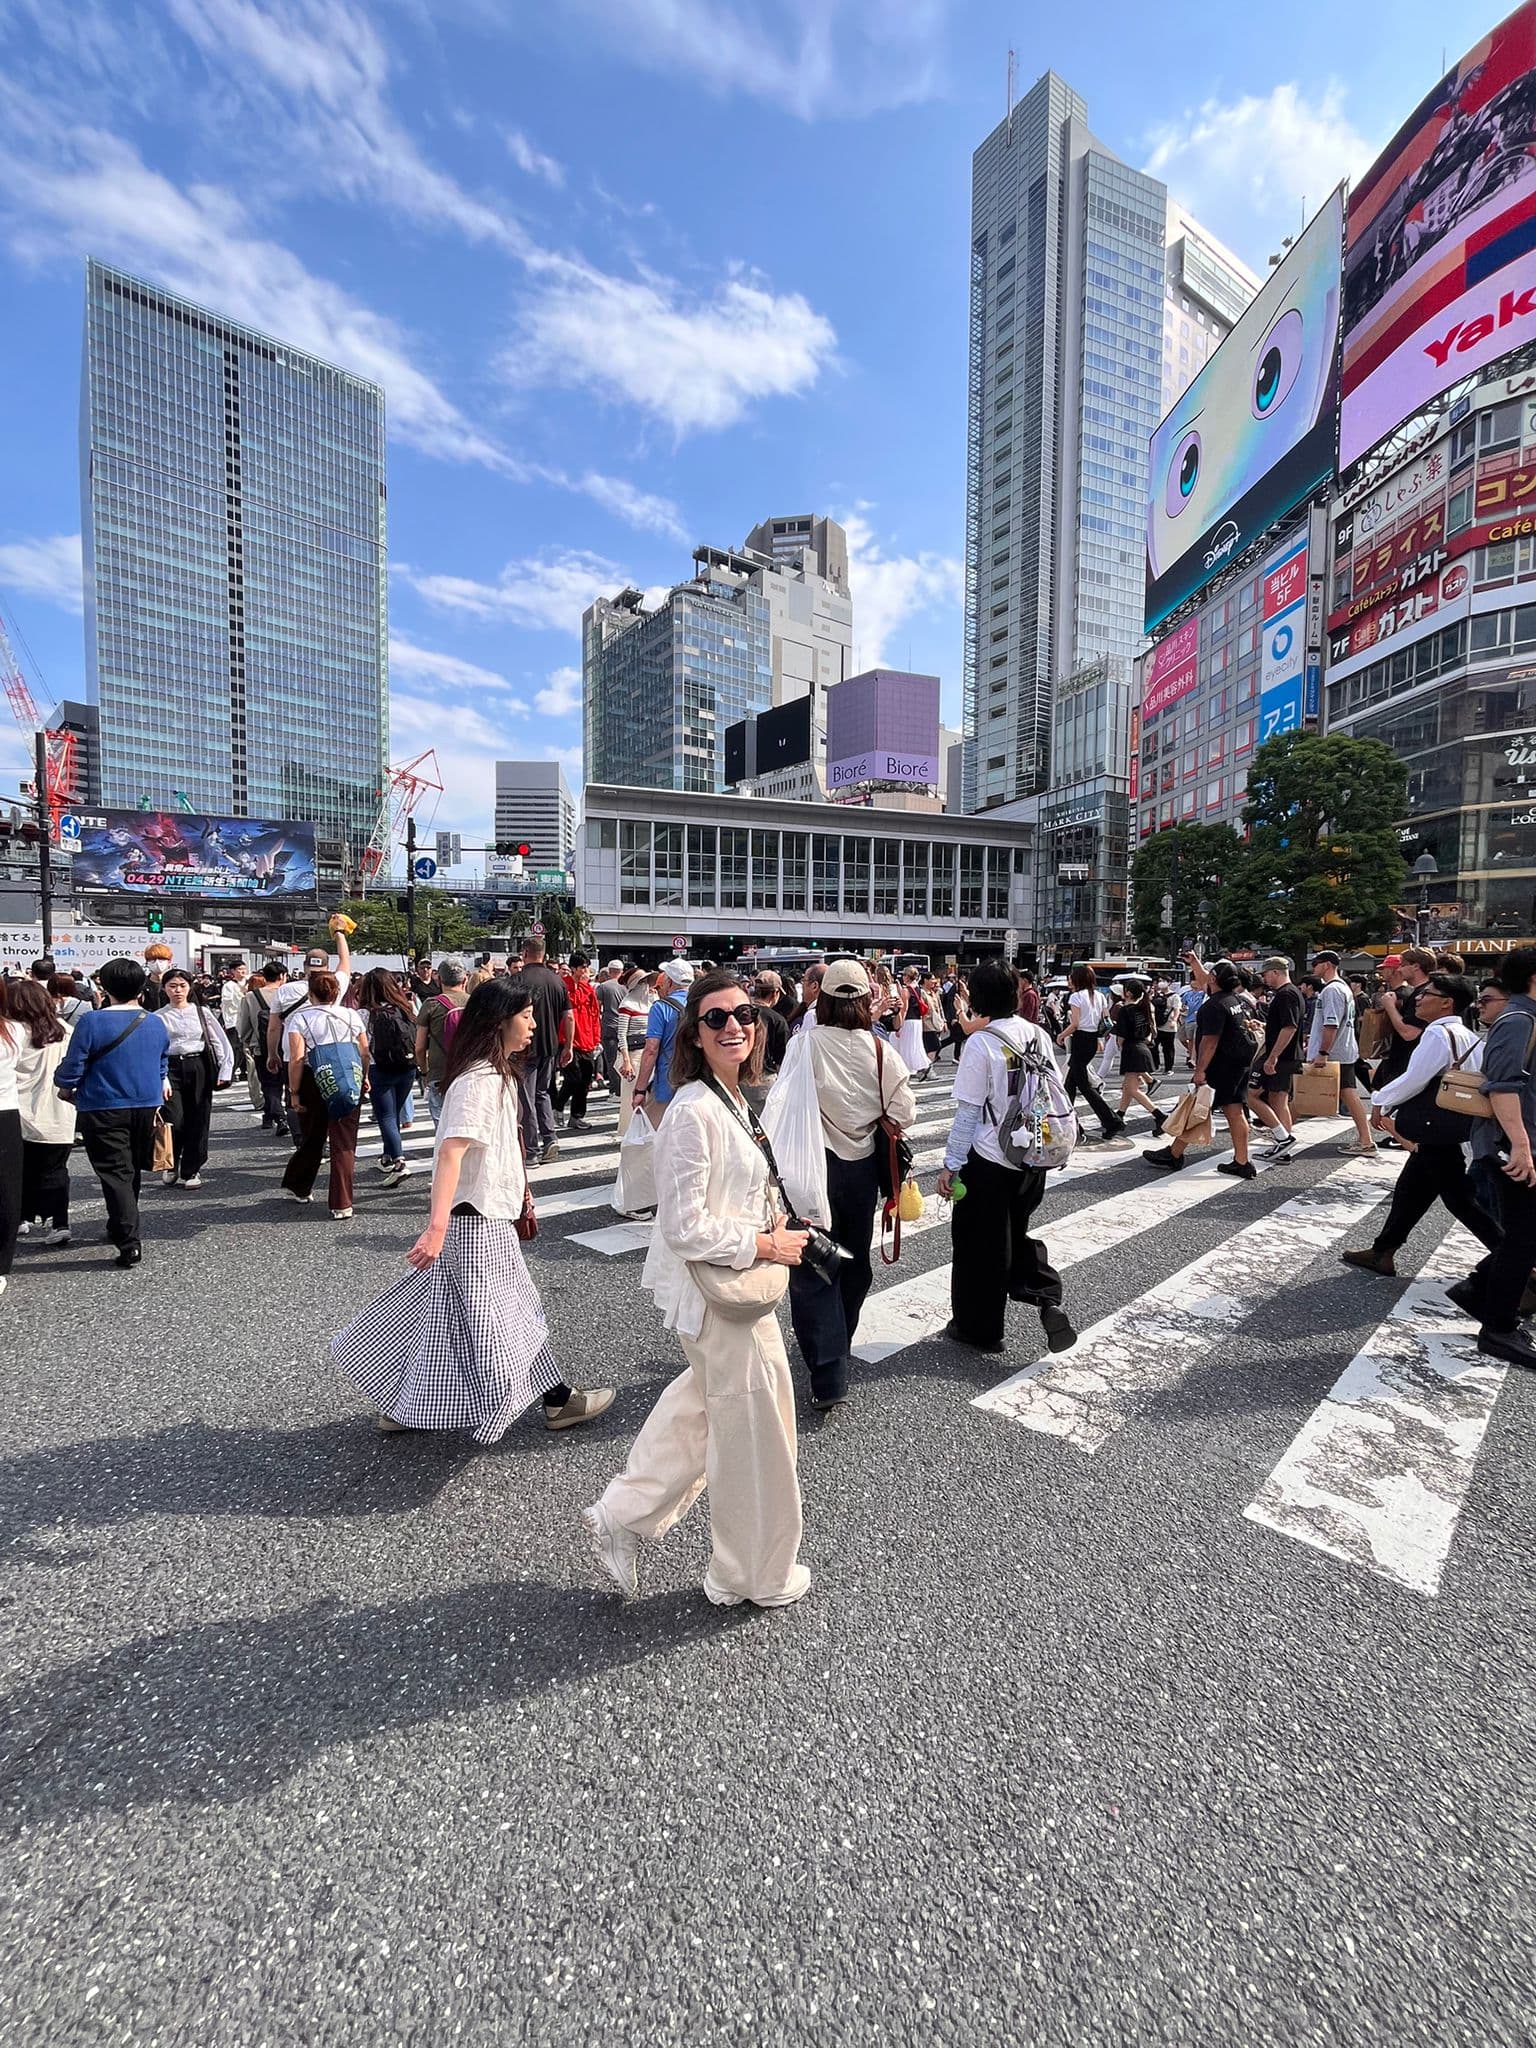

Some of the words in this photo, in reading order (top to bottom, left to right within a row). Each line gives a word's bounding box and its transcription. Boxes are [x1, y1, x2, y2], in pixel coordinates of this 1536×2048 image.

[1337, 524, 1353, 546] 9F
[1270, 565, 1299, 594] 当ビル
[1401, 549, 1448, 590] ガスト
[1276, 586, 1292, 606] 5F
[1378, 591, 1434, 642] ガスト
[1332, 635, 1350, 658] 7F
[833, 758, 867, 783] Bioré
[886, 757, 929, 777] Bioré
[1043, 815, 1072, 830] MARK
[1075, 806, 1105, 821] CITY
[3, 946, 39, 956] throw
[82, 949, 103, 957] you
[107, 948, 131, 956] lose
